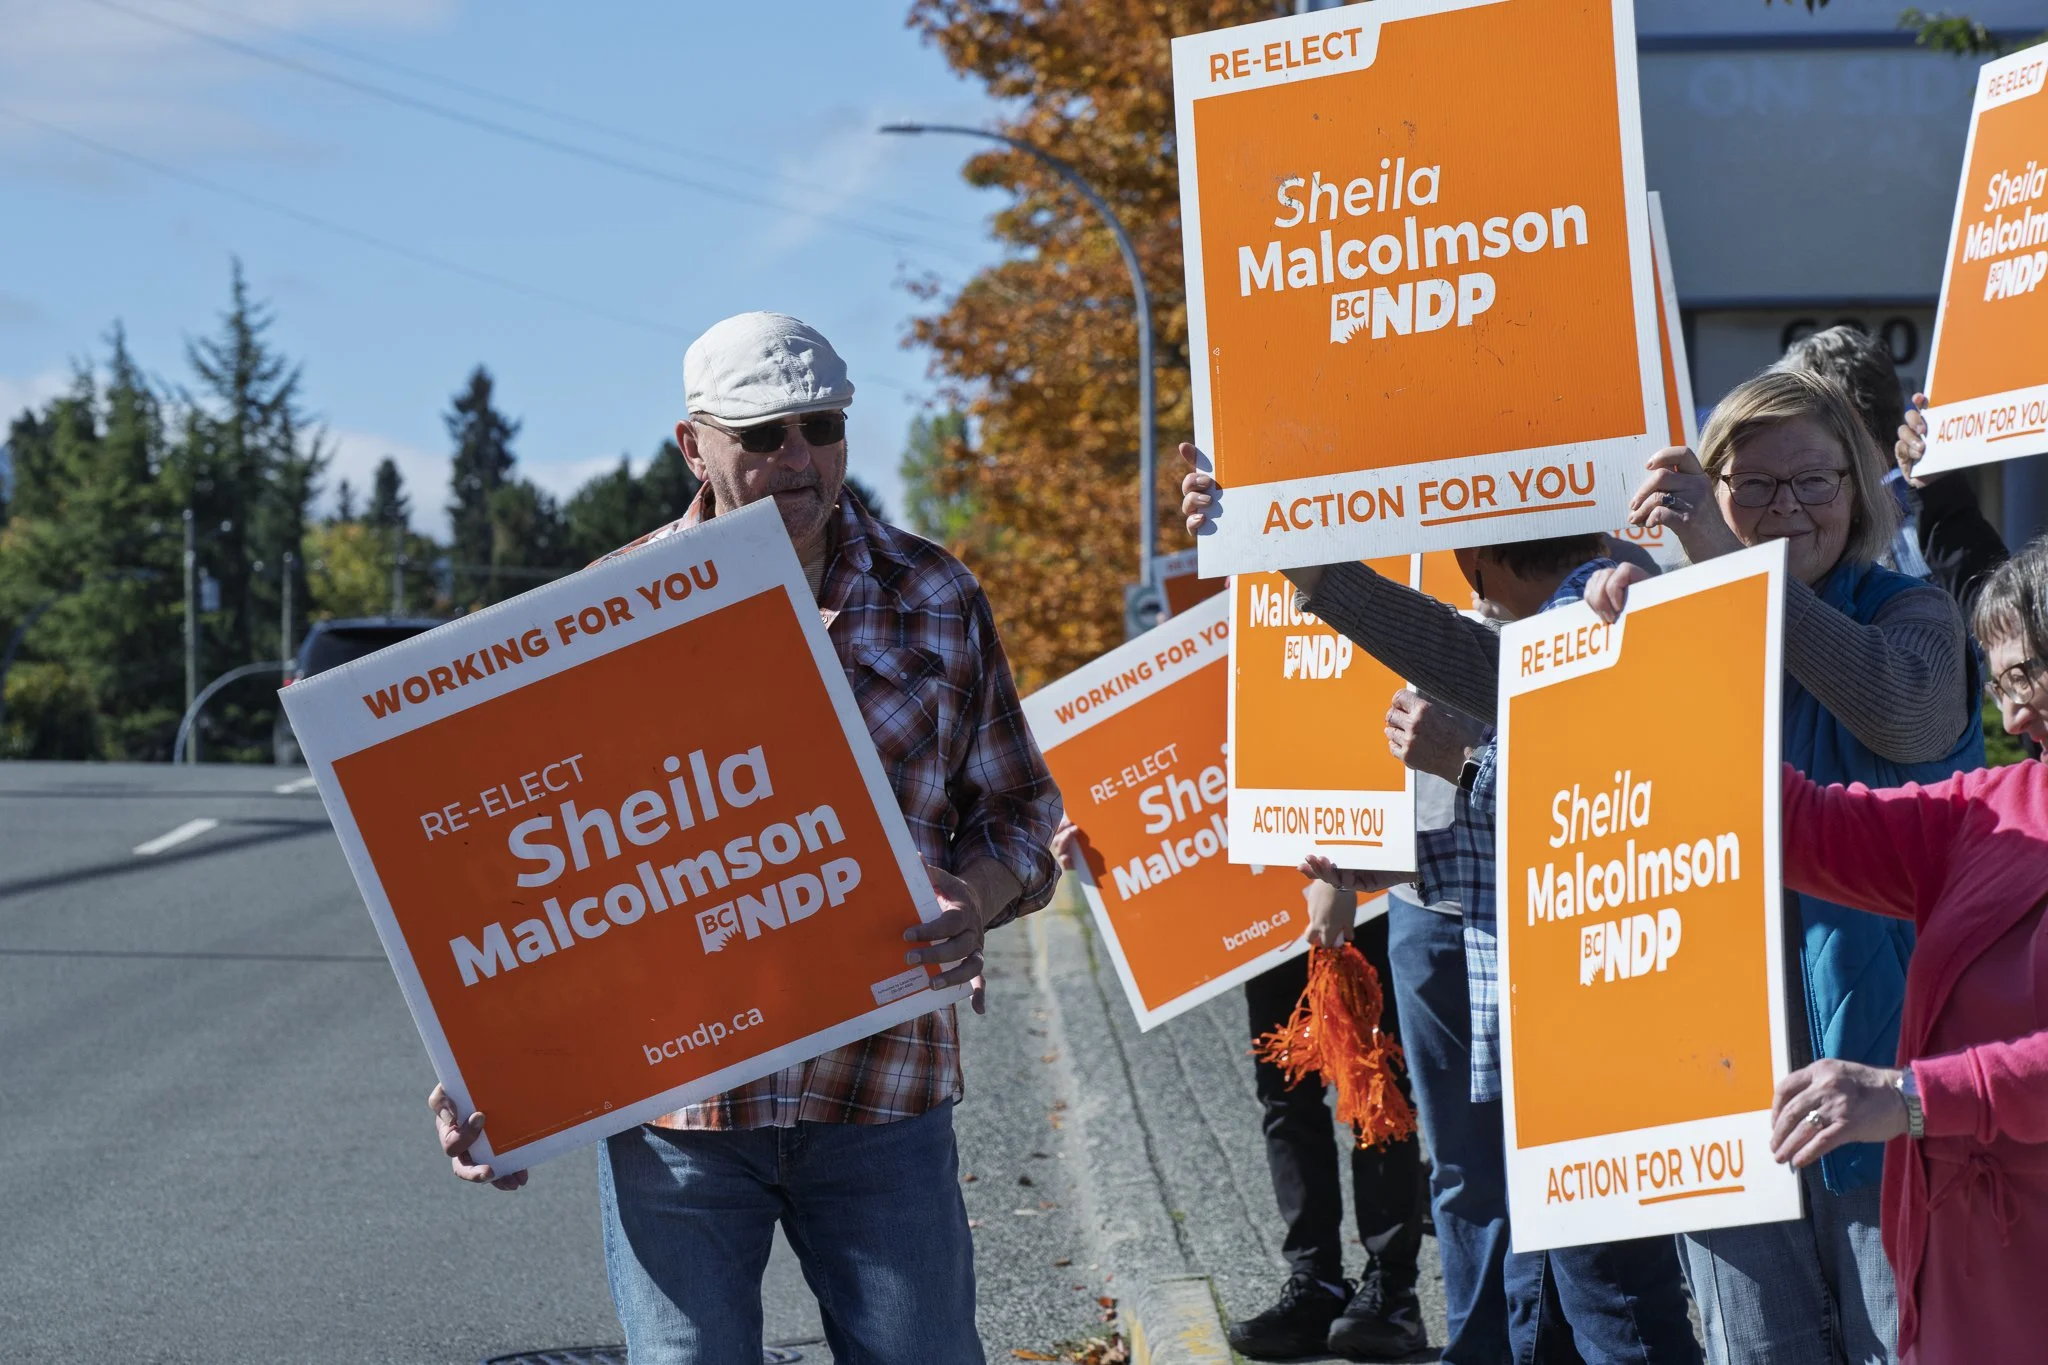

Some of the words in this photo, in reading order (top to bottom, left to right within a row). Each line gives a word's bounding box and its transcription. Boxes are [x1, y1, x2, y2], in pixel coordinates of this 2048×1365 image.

[1209, 27, 1363, 82] RE-ELECT
[1986, 60, 2043, 100] RE-ELECT
[1274, 156, 1441, 228] Sheila
[1984, 160, 2048, 212] Sheila
[1238, 204, 1588, 297] Malcolmson
[1963, 206, 2048, 264] Malcolm
[1372, 272, 1496, 340] NDP
[1937, 411, 1986, 444] ACTION
[1988, 405, 2017, 434] FOR
[1263, 485, 1404, 535] ACTION
[1418, 474, 1496, 515] FOR
[1508, 461, 1596, 502] YOU
[363, 629, 550, 720] WORKING
[557, 596, 635, 647] FOR
[637, 560, 720, 611] YOU
[1055, 661, 1153, 725] WORKING
[1155, 639, 1198, 671] FOR
[1198, 621, 1229, 646] YO
[1300, 634, 1353, 680] NDP
[1521, 622, 1611, 678] RE-ELECT
[419, 754, 586, 842] RE-ELECT
[1090, 743, 1178, 805] RE-ELECT
[1549, 769, 1652, 848] Sheila
[508, 744, 774, 888] Sheila
[1253, 806, 1309, 835] ACTION
[1315, 807, 1345, 836] FOR
[1350, 808, 1384, 837] YOU
[1111, 813, 1228, 901] Malcol
[1527, 832, 1740, 927] Malcolmson
[448, 804, 846, 987] Malcolmson
[739, 856, 862, 941] NDP
[1222, 910, 1291, 951] bcndp.ca
[1604, 907, 1682, 983] NDP
[642, 1007, 764, 1067] bcndp.ca
[1547, 1156, 1629, 1205] ACTION
[1635, 1148, 1685, 1192] FOR
[1690, 1139, 1744, 1183] YOU
